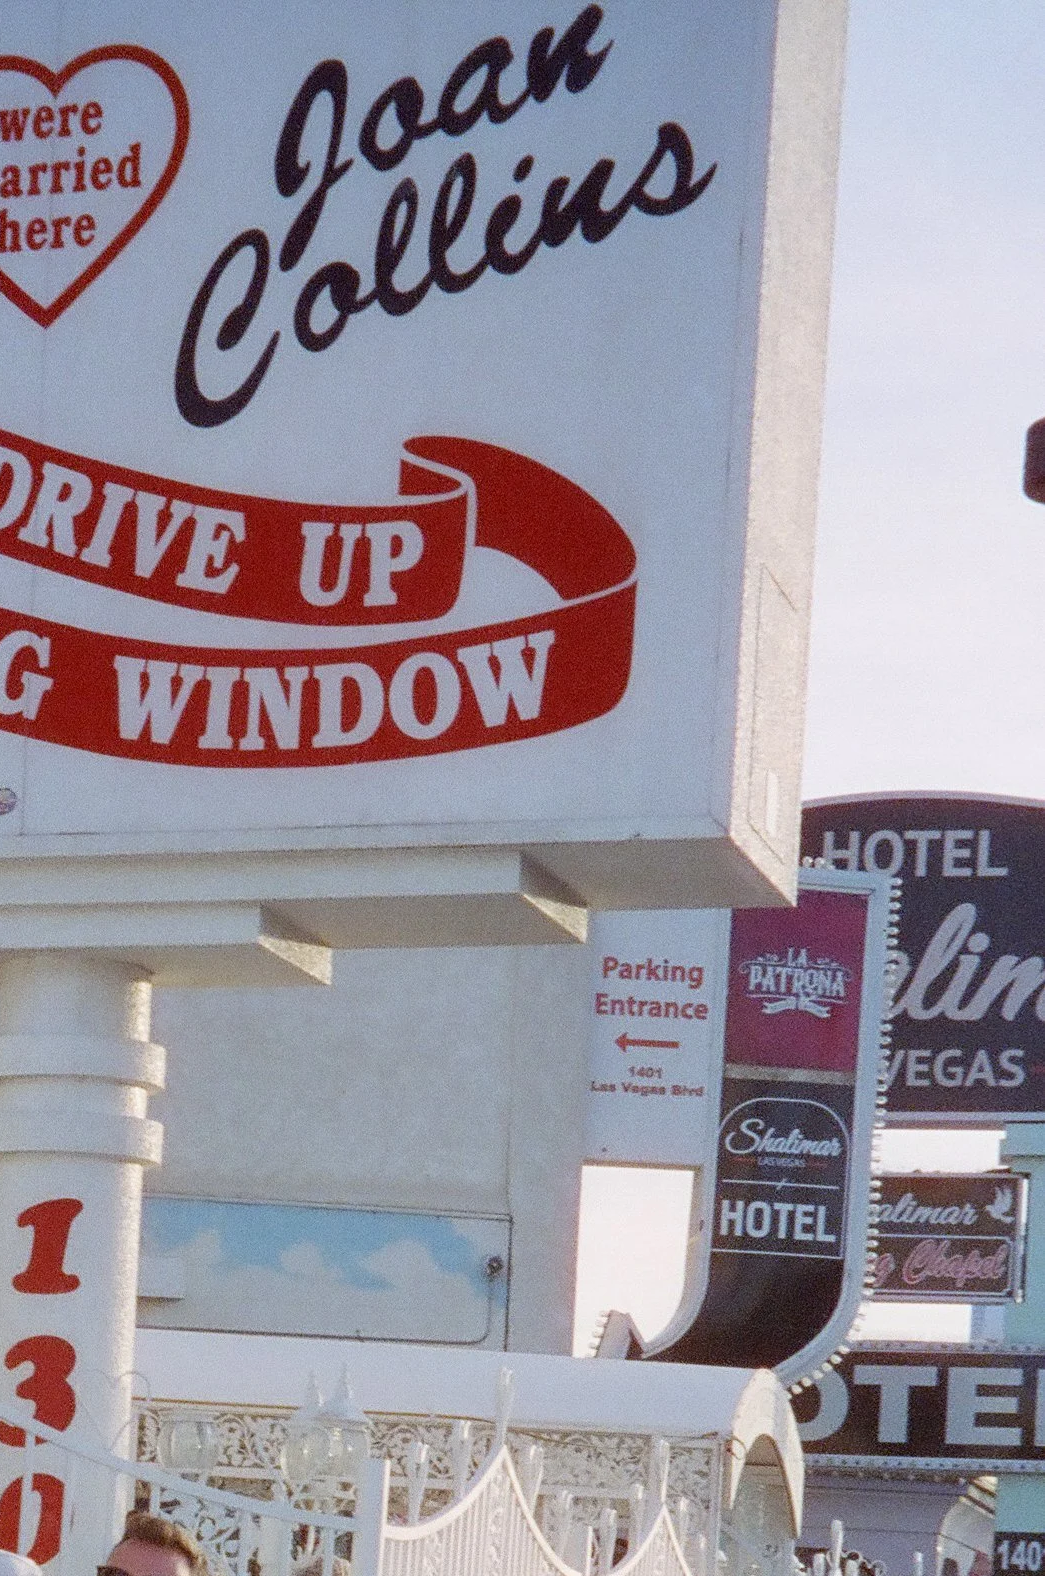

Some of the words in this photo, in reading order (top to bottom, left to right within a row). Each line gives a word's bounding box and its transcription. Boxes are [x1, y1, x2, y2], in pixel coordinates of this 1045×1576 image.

[274, 3, 613, 271] Joan
[174, 121, 717, 428] Collins
[298, 520, 425, 608] UP
[112, 630, 556, 751] WINDOW
[822, 829, 1009, 877] HOTEL
[602, 956, 704, 990] Parking
[787, 947, 808, 967] LA
[748, 964, 846, 998] PATRONA
[594, 993, 709, 1021] Entrance
[590, 1081, 617, 1093] Las
[621, 1082, 666, 1097] Vegas
[671, 1084, 705, 1098] Blvd
[628, 1066, 664, 1079] 1401
[724, 1118, 843, 1157] Shalimar
[719, 1199, 836, 1243] HOTEL
[902, 1239, 1009, 1288] Chapel
[797, 1365, 1045, 1447] OTE
[997, 1539, 1045, 1572] 140
